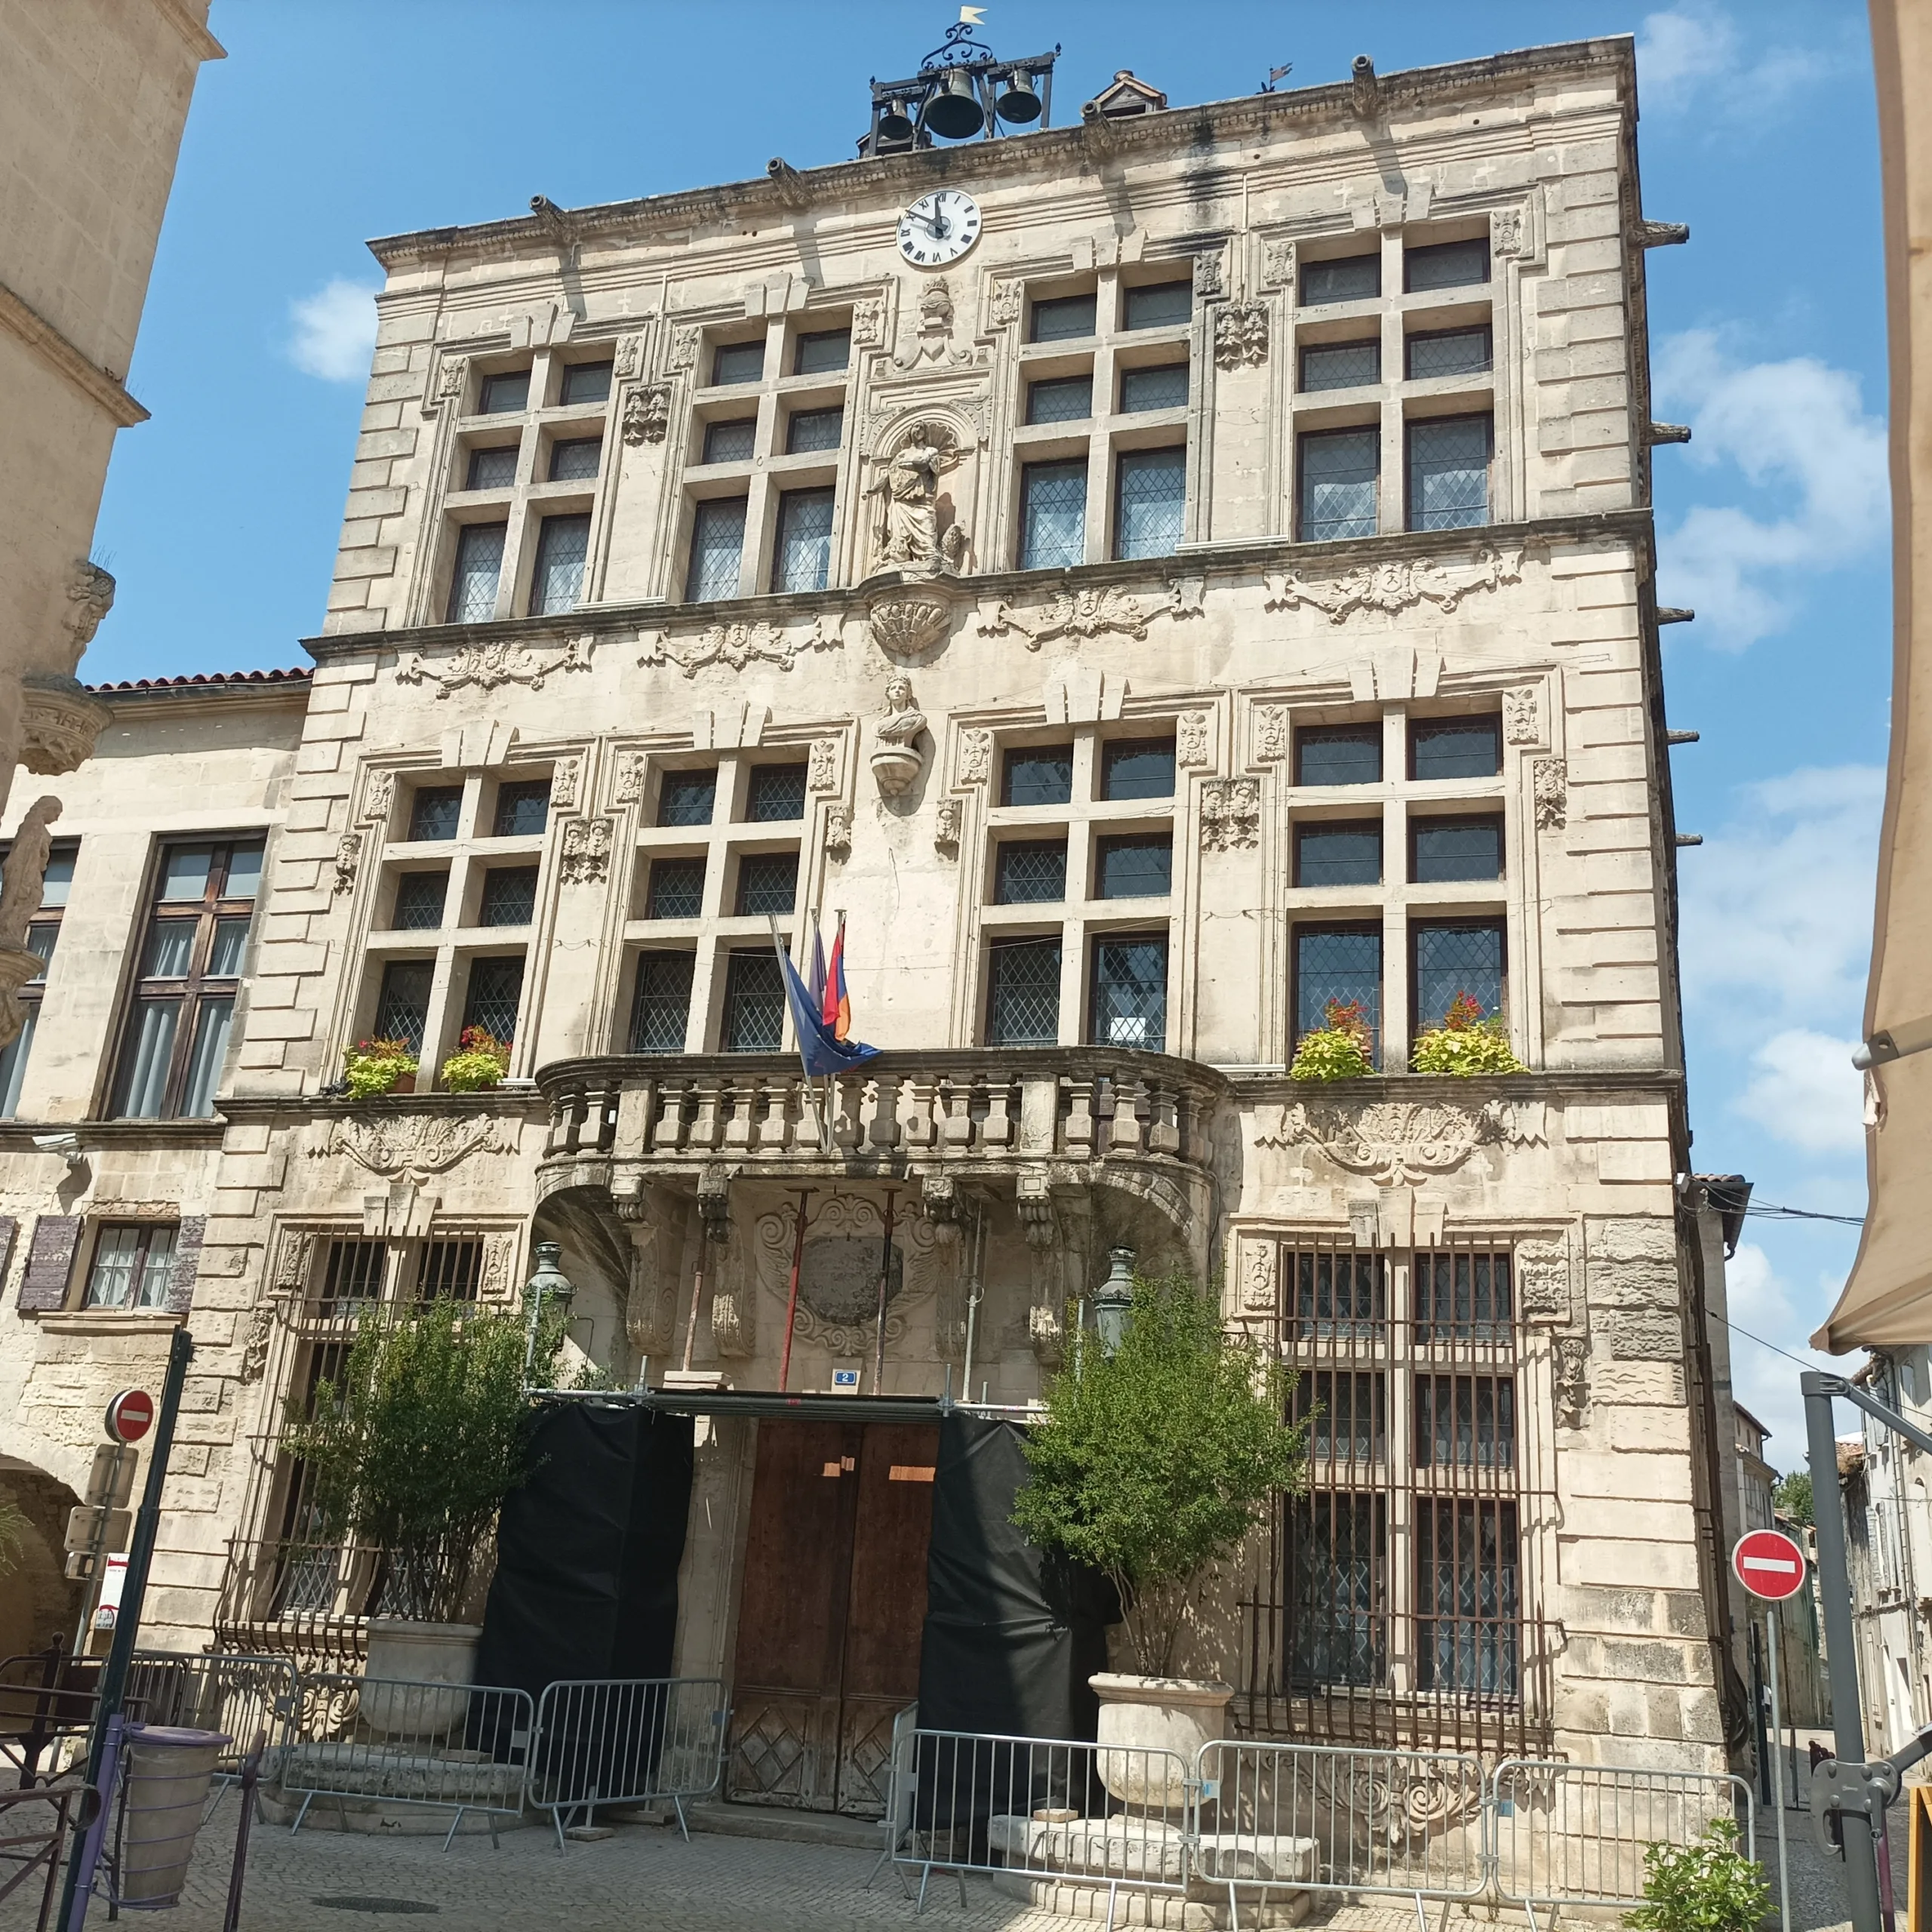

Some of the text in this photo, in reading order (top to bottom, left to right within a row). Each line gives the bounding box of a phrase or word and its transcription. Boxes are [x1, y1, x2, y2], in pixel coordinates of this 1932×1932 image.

[918, 199, 928, 210] XI
[900, 229, 910, 237] IX
[949, 248, 958, 257] V
[932, 252, 941, 263] VI
[841, 1373, 849, 1382] 2
